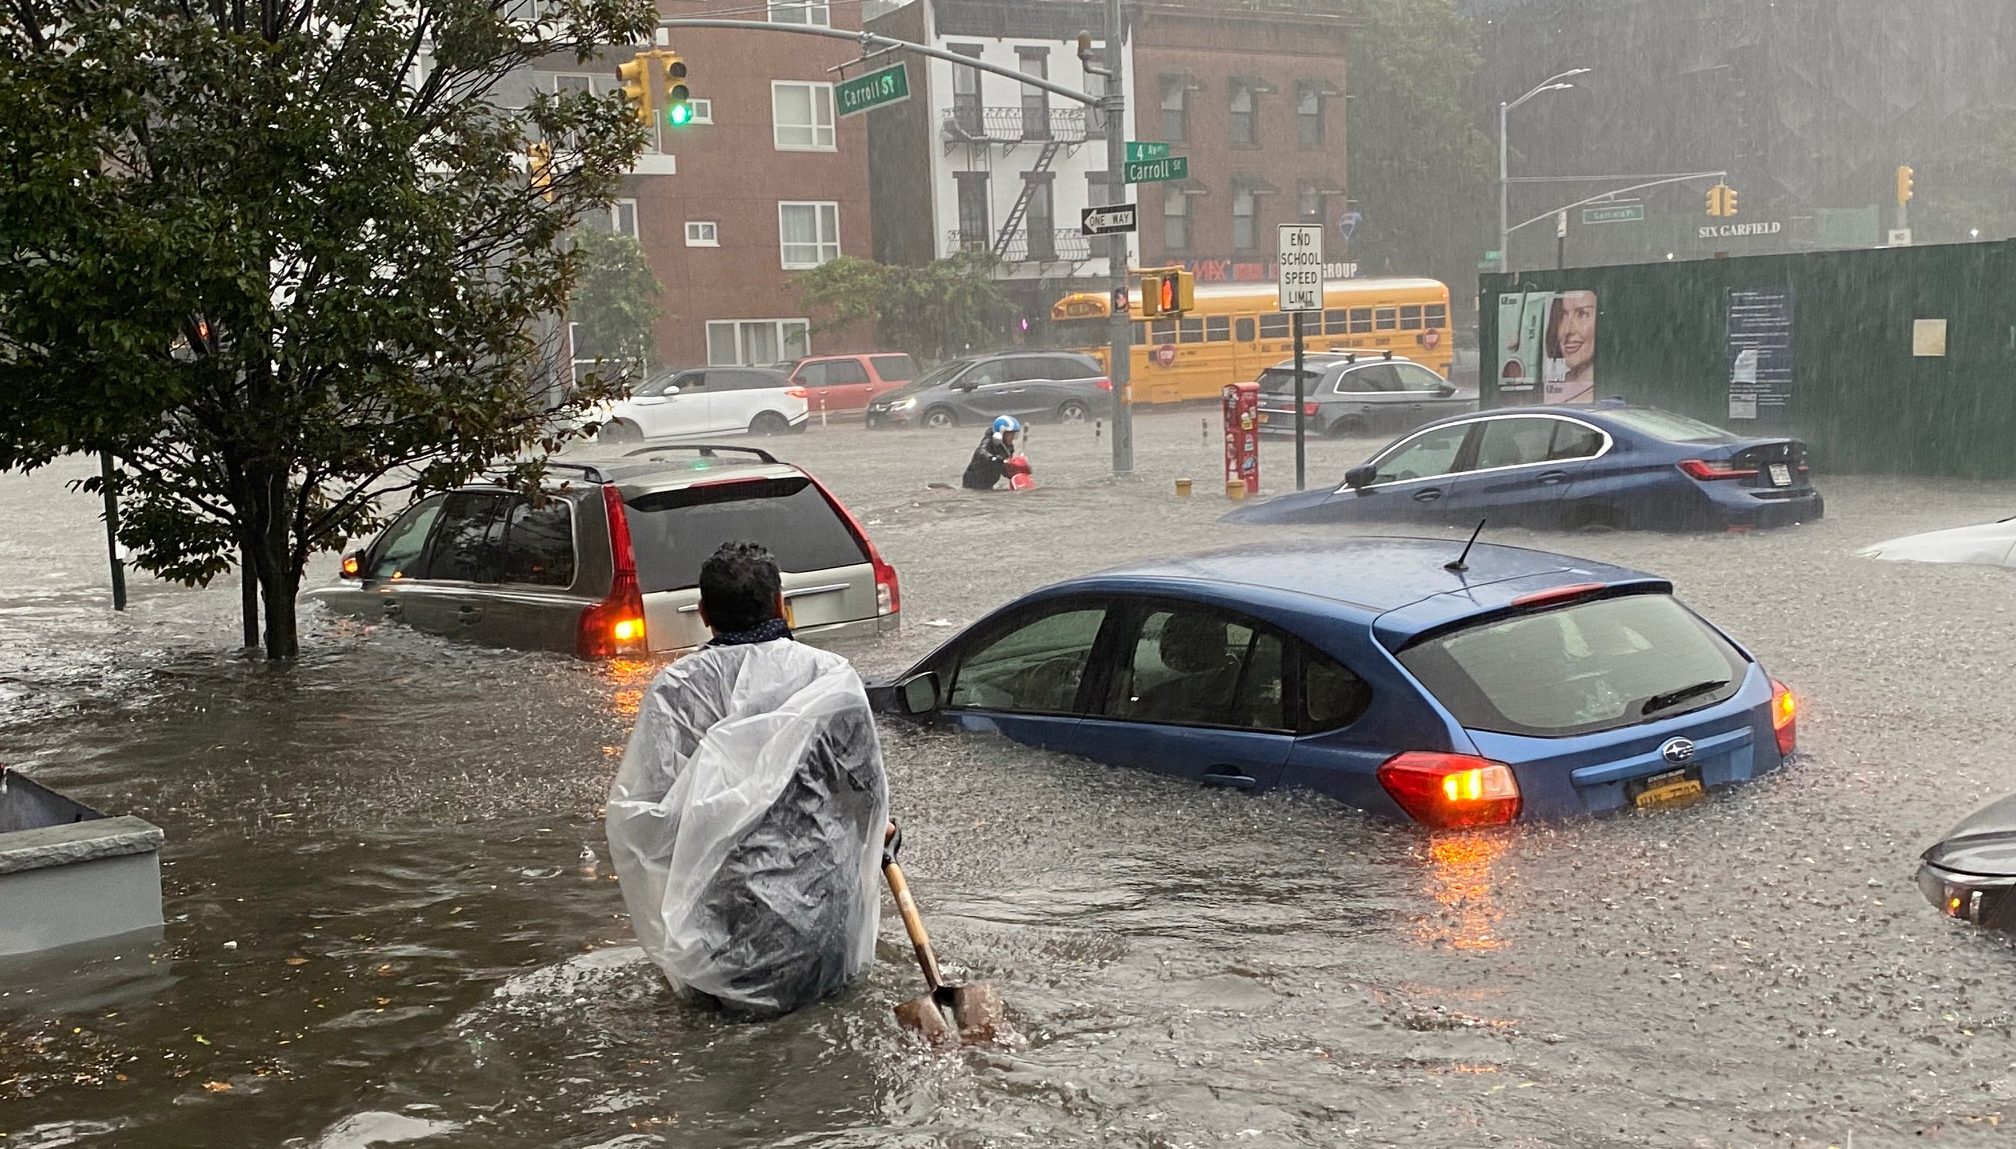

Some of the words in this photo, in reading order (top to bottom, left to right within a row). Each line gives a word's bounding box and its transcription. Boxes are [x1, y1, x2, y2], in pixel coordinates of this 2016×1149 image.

[844, 80, 880, 107] Carroll
[881, 75, 895, 96] St
[1137, 145, 1144, 160] 4
[1130, 161, 1169, 180] Carroll
[1089, 215, 1105, 227] ONE
[1112, 213, 1129, 225] WAY
[1699, 226, 1718, 238] SIX
[1720, 221, 1781, 237] GARFIELD
[1290, 233, 1311, 246] END
[1281, 253, 1321, 266] SCHOOL
[1285, 271, 1318, 285] SPEED
[1289, 290, 1313, 304] LIMIT
